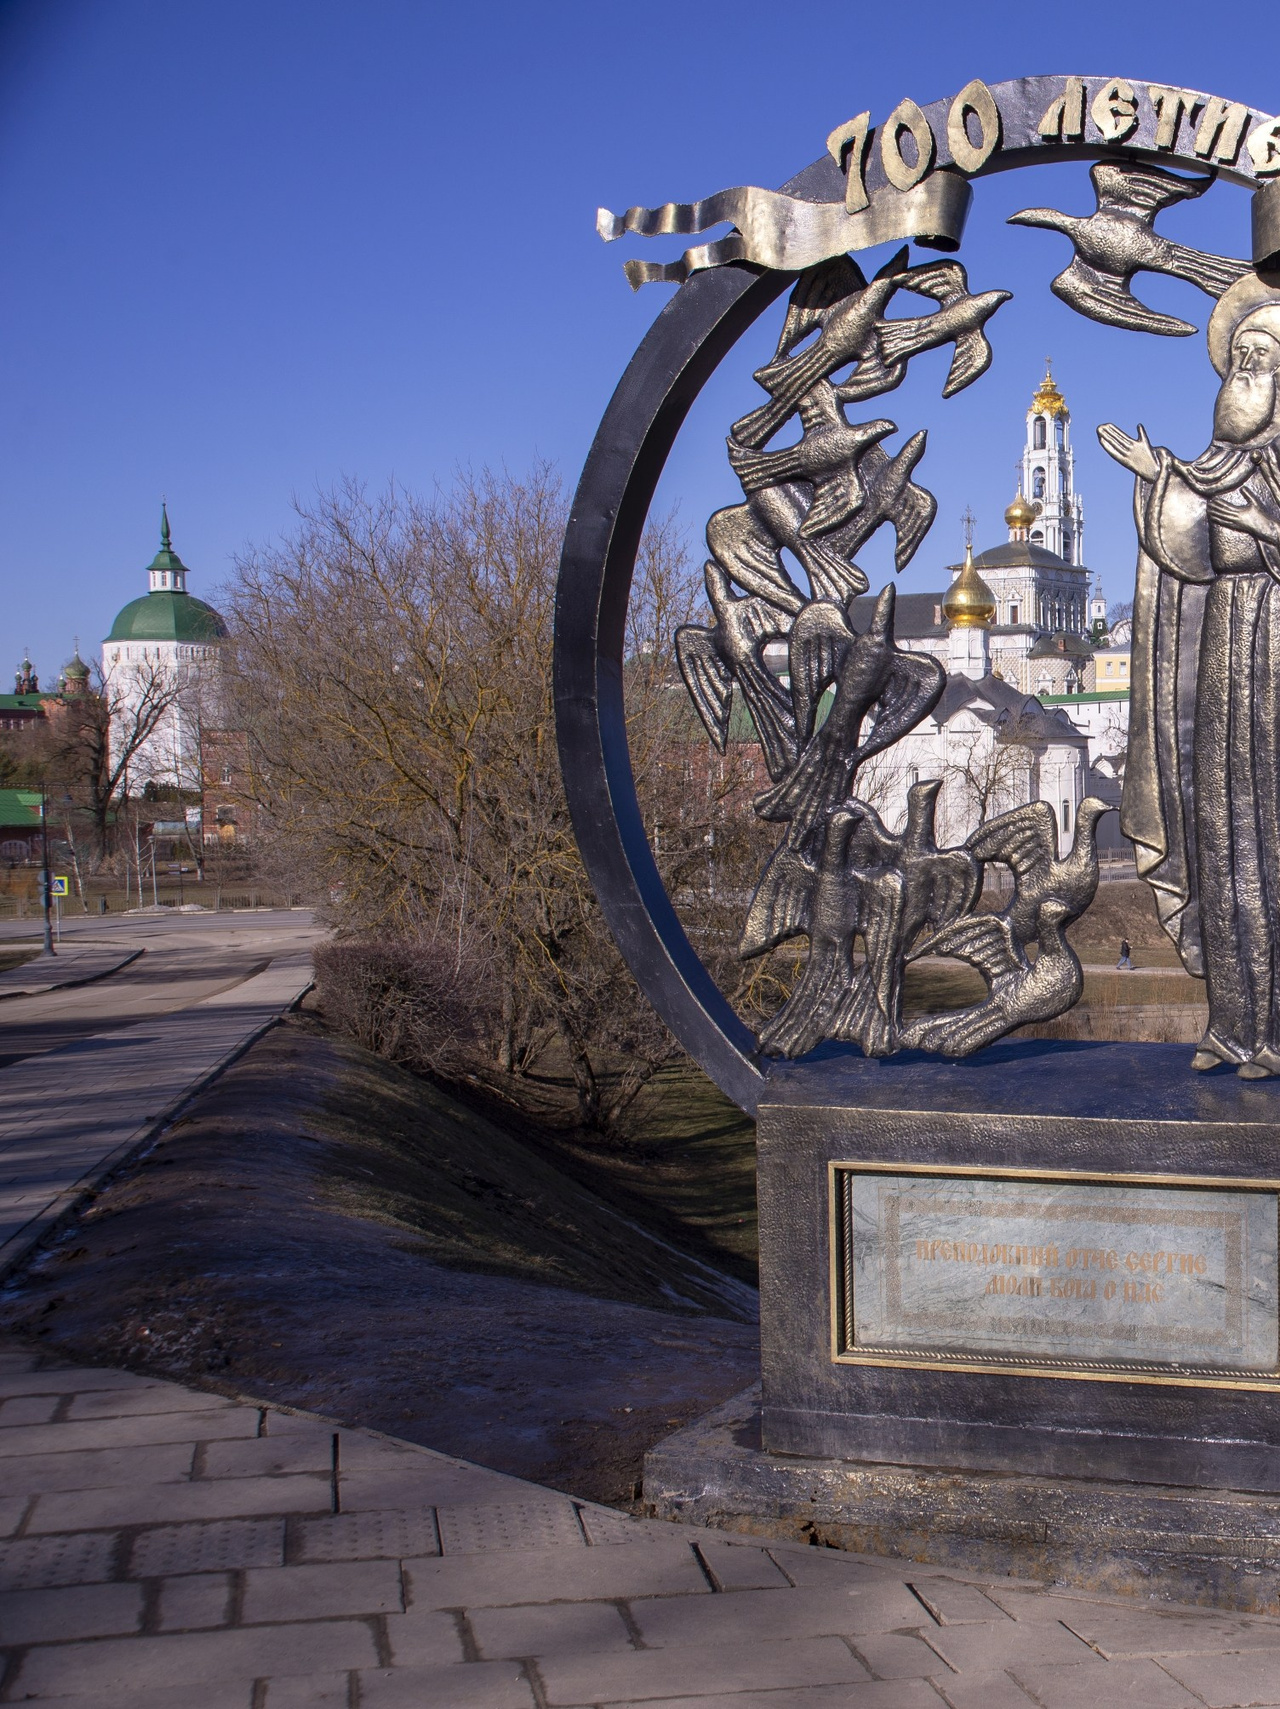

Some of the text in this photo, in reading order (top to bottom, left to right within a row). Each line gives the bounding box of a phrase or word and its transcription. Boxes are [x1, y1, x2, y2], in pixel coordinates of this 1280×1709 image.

[826, 78, 999, 214] 700
[1065, 1247, 1118, 1271] ОТЧЕ
[1125, 1250, 1207, 1275] СЕРГИЕ
[985, 1274, 1042, 1297] МОЛИ
[1123, 1280, 1164, 1303] НАС
